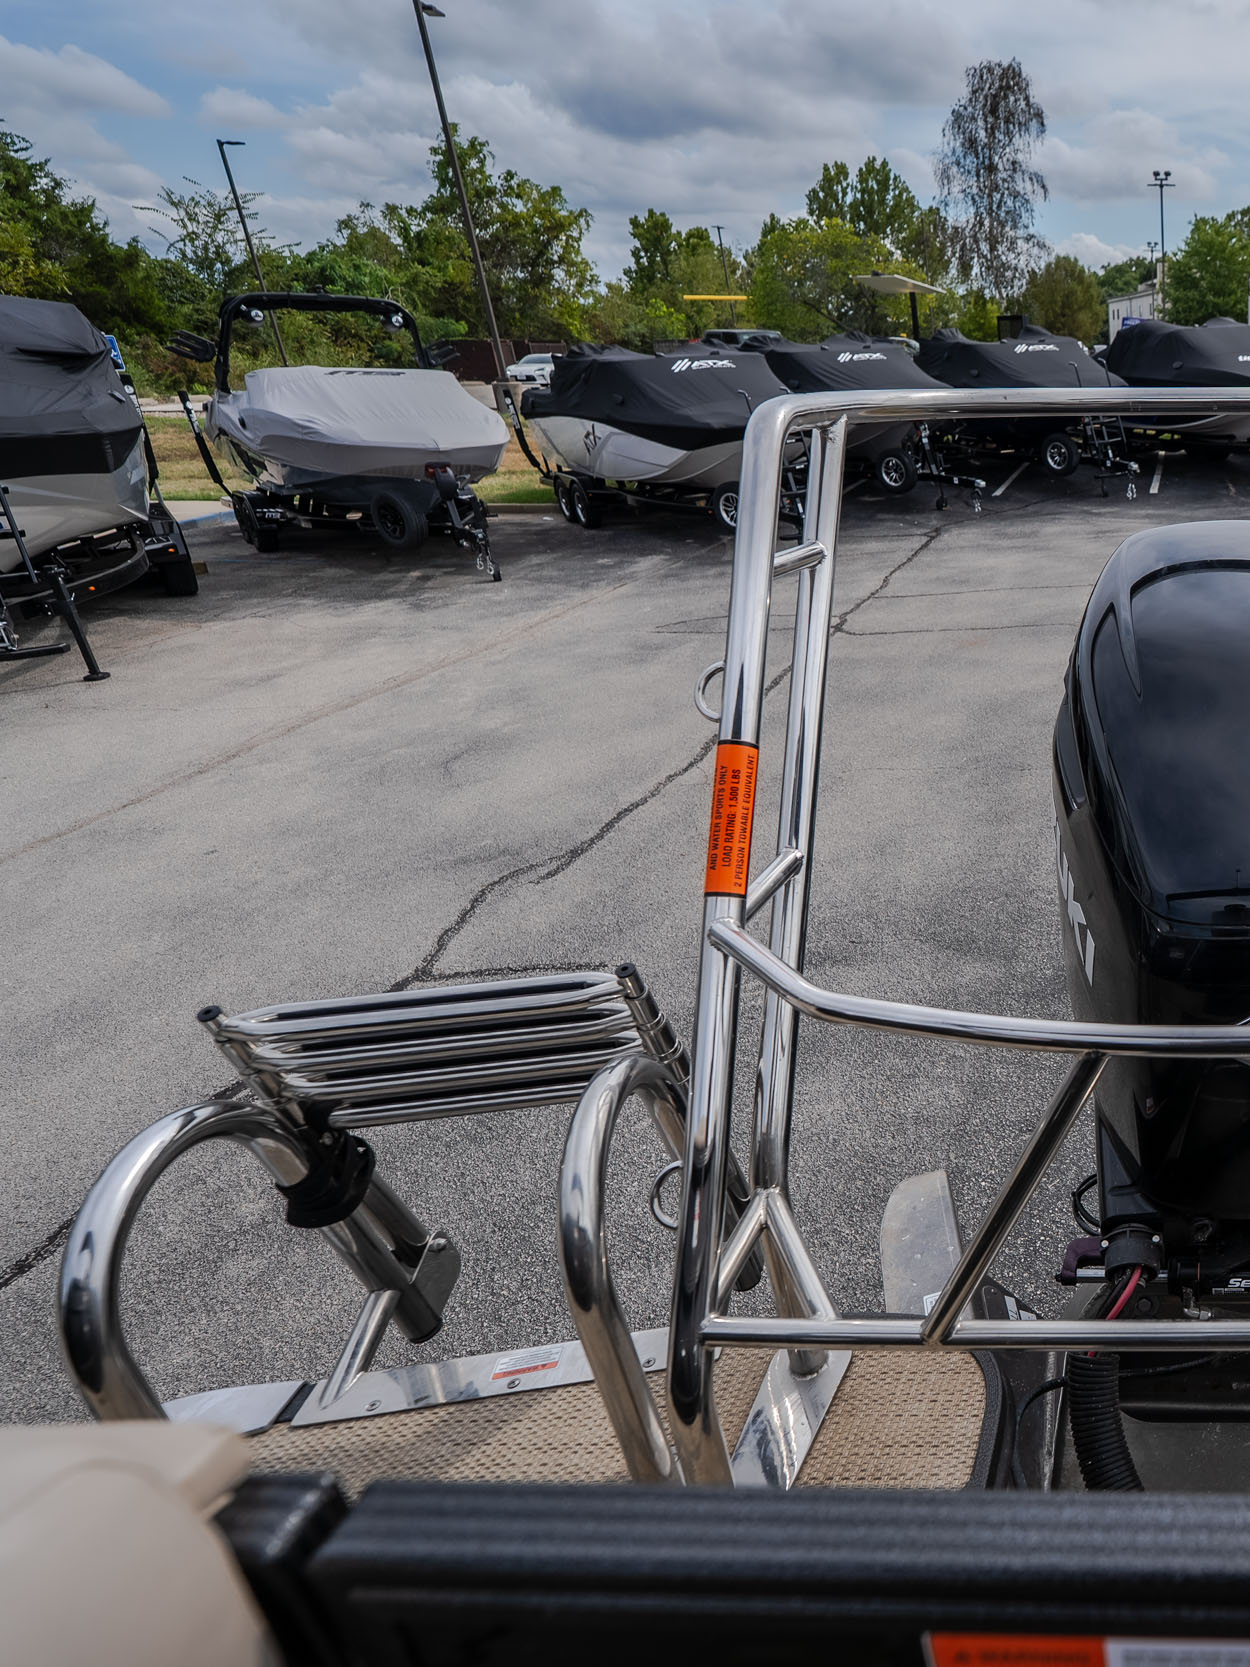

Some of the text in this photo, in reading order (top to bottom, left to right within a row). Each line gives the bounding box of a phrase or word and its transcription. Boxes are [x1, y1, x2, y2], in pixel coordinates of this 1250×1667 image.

[719, 765, 728, 785] ONLY
[743, 754, 755, 804] EQUIVALENT
[715, 788, 726, 820] SPORTS
[721, 769, 742, 867] LOAD RATING: 1,500 LBS
[711, 822, 721, 851] WATER
[738, 805, 750, 844] TOWABLE
[709, 853, 718, 871] AND
[735, 846, 745, 880] PERSON
